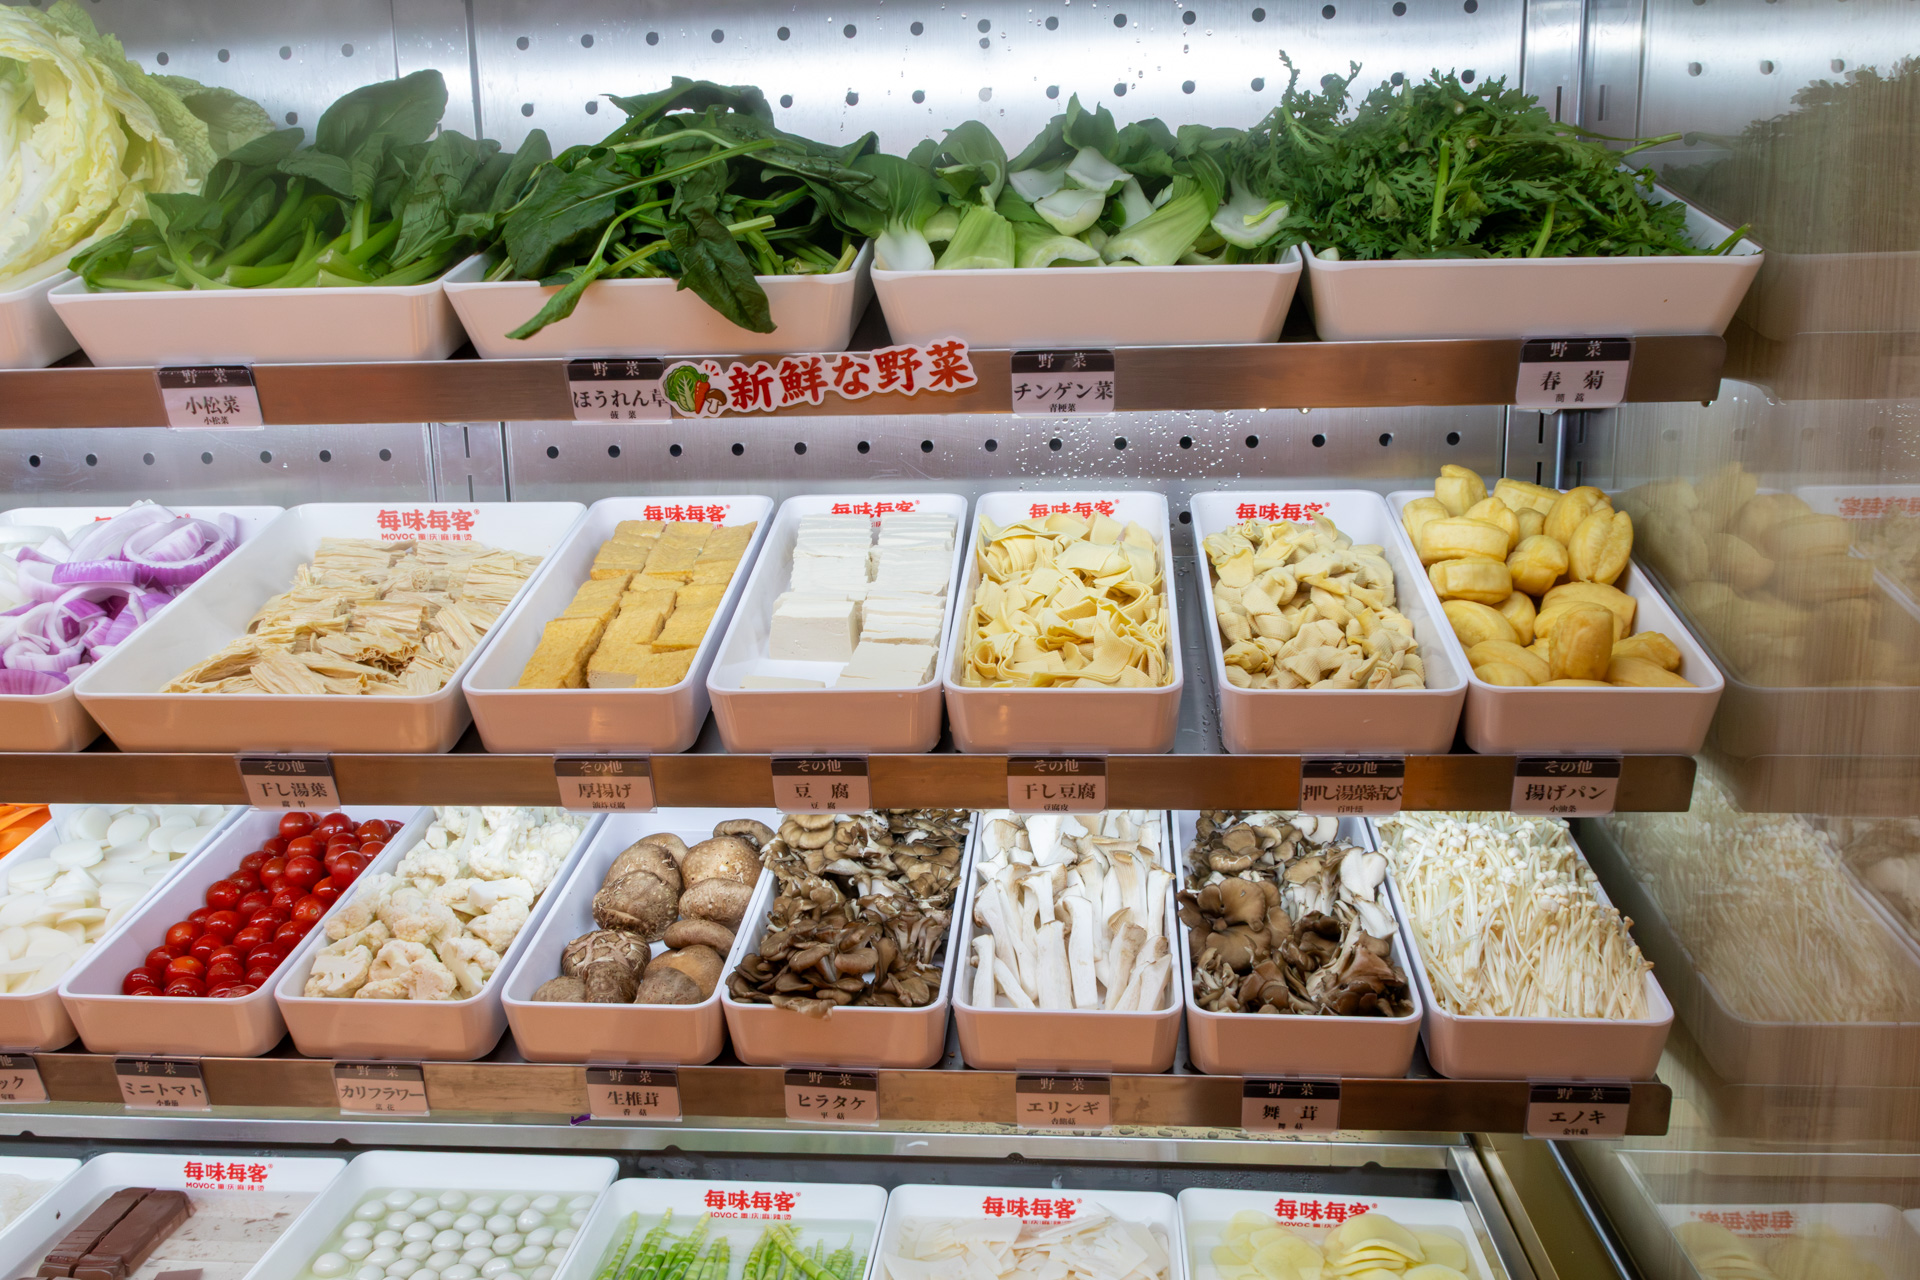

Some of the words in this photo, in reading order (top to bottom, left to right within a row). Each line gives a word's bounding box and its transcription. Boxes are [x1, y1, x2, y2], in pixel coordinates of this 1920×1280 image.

[1550, 340, 1602, 357] 野菜
[592, 360, 639, 376] 野菜
[1038, 352, 1086, 368] 野菜
[727, 340, 974, 410] 新鮮な野菜
[1540, 370, 1604, 391] 春菊
[1014, 380, 1113, 401] チンゲン菜
[186, 395, 240, 414] 小松菜
[204, 416, 229, 425] 小松菜
[376, 508, 475, 532] 每味每客
[264, 760, 306, 773] その他
[580, 760, 623, 773] その他
[797, 759, 842, 772] その他
[1034, 759, 1079, 772] その他
[1331, 761, 1377, 774] その他
[1545, 760, 1593, 774] その他
[256, 782, 327, 797] 干し湯葉
[578, 783, 631, 798] 厚揚げ
[794, 783, 849, 799] 豆腐
[1021, 782, 1096, 800] 干し豆腐
[1525, 784, 1608, 801] 揚げパン
[126, 1082, 202, 1097] ミニトマト
[341, 1085, 424, 1101] カリフラワー
[607, 1091, 660, 1107] 生椎茸
[798, 1094, 865, 1110] ヒラタケ
[1027, 1102, 1099, 1115] エリンギ
[1262, 1105, 1318, 1120] 舞茸
[1549, 1110, 1606, 1124] エノキ
[184, 1161, 268, 1183] 每味每客
[704, 1189, 795, 1212] 每味每客
[982, 1196, 1076, 1219] 每味每客
